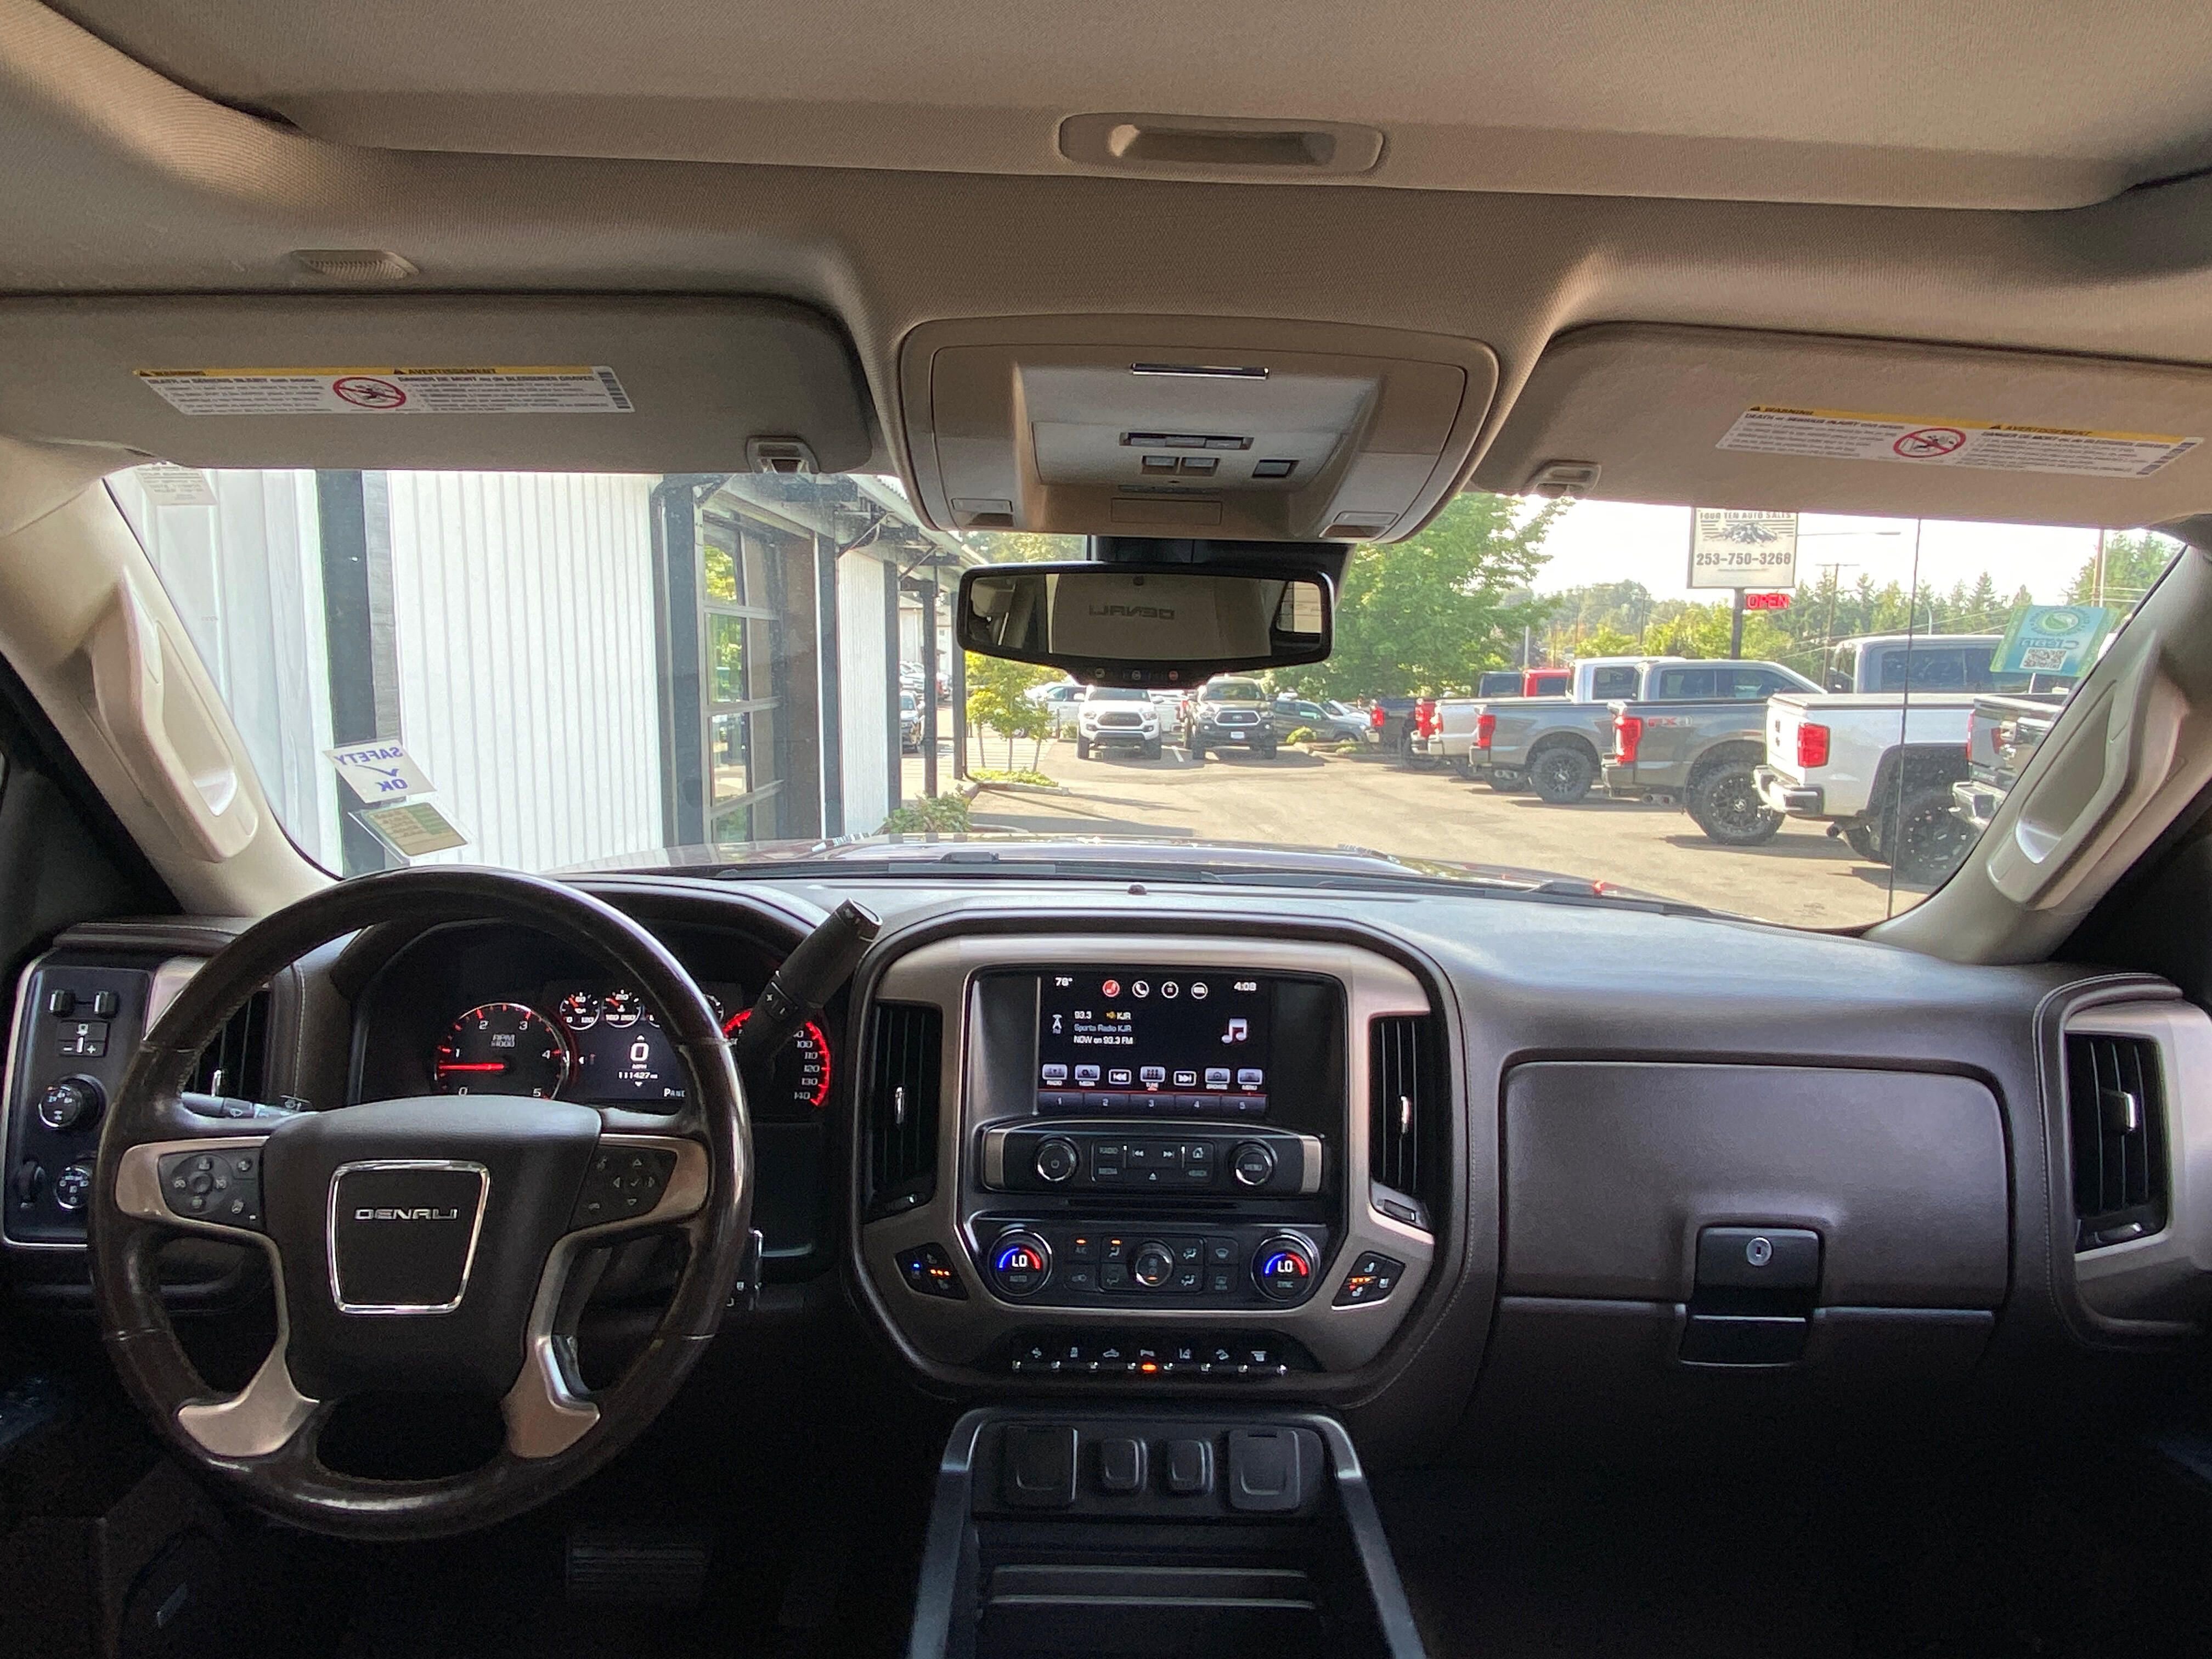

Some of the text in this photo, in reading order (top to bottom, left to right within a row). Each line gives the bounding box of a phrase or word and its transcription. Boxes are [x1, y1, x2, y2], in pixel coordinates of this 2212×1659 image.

[1724, 511, 1740, 520] TEN
[1696, 552, 1792, 566] 253-750-3268
[1747, 594, 1791, 609] OPEN
[479, 1020, 489, 1029] 2
[518, 1020, 528, 1030] 3
[797, 1040, 813, 1048] 100
[1073, 1035, 1093, 1043] NOW
[1121, 1036, 1134, 1045] FM
[455, 1048, 461, 1058] 1
[541, 1049, 551, 1059] 4
[630, 1042, 650, 1062] 0
[804, 1065, 820, 1073] 120
[458, 1086, 468, 1096] 0
[533, 1087, 542, 1097] 5
[794, 1092, 811, 1100] 140
[1057, 1097, 1062, 1105] 1
[1102, 1098, 1109, 1107] 2
[1148, 1099, 1155, 1108] 3
[1239, 1102, 1246, 1110] 5
[354, 1209, 458, 1220] DENALI
[1011, 1255, 1028, 1268] LO
[1277, 1260, 1294, 1273] LO
